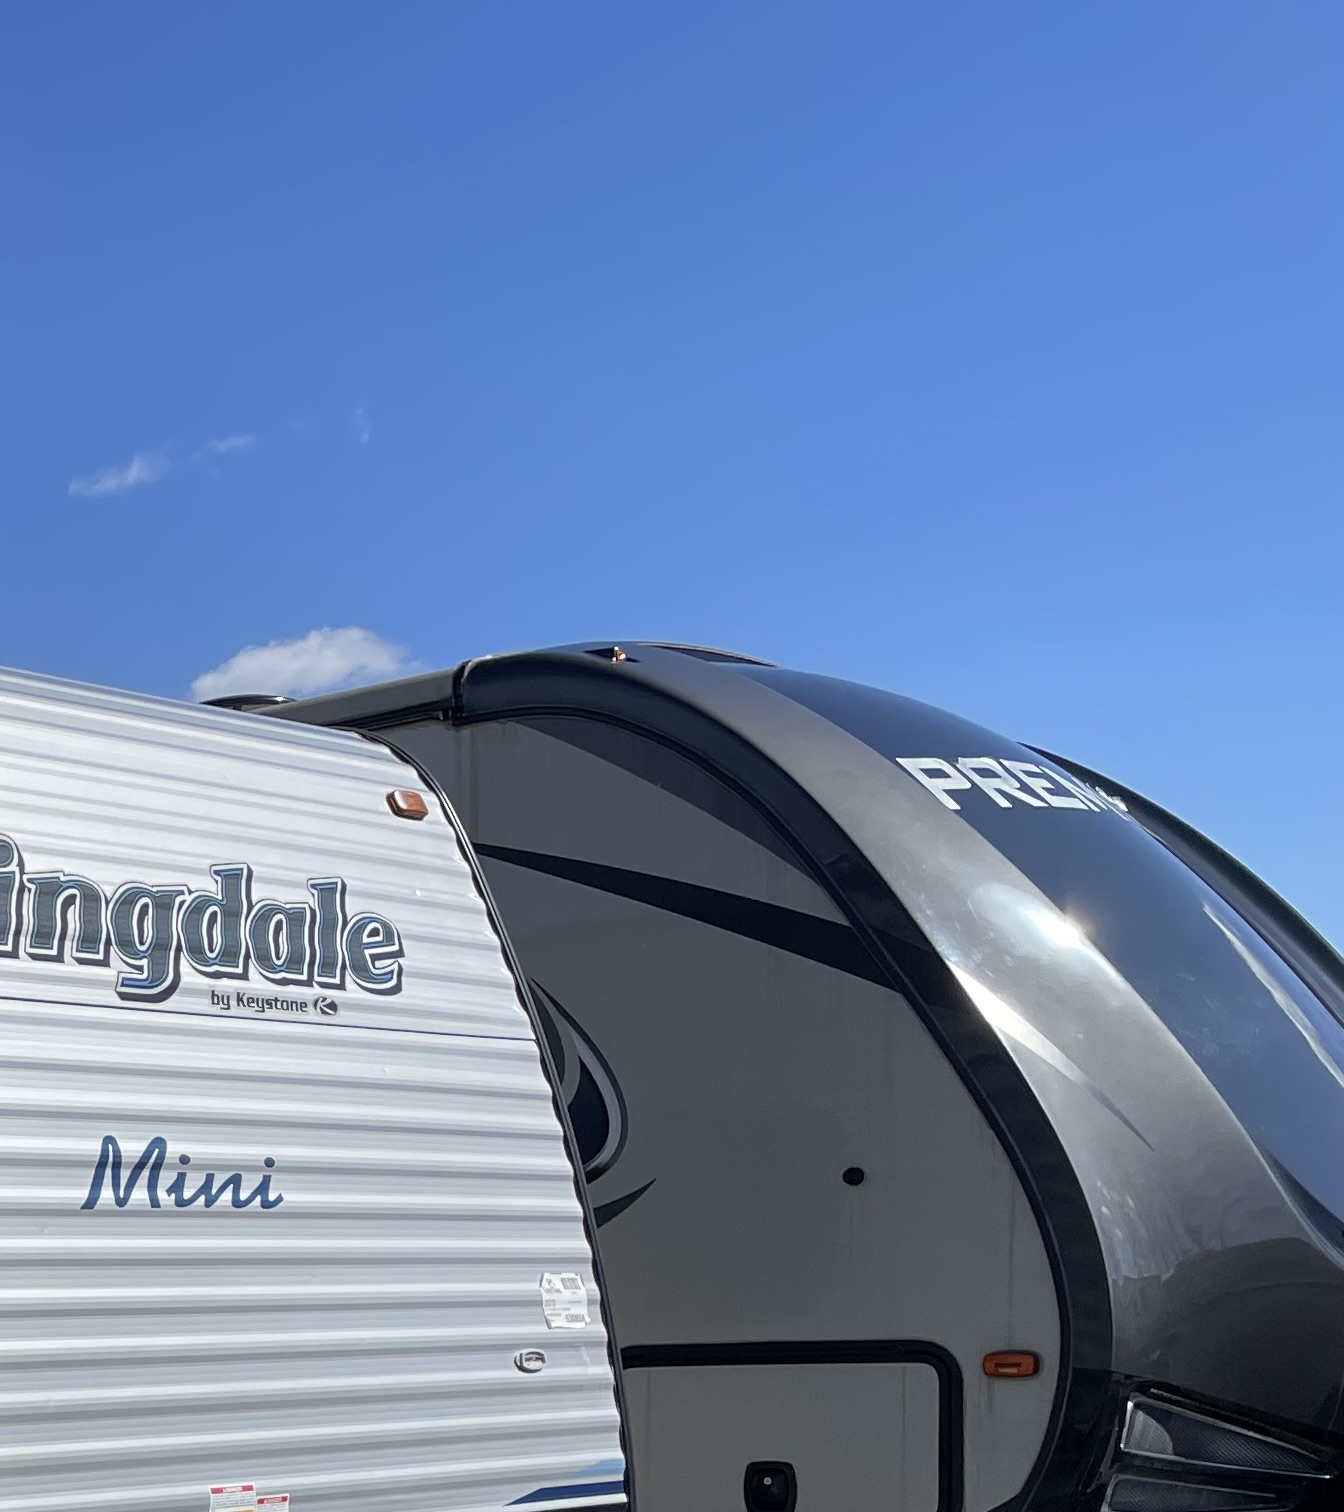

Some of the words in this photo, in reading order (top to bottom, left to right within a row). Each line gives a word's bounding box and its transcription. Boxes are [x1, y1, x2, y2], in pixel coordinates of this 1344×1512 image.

[896, 756, 1130, 821] PREM
[211, 989, 231, 1011] by
[236, 991, 309, 1013] Keystone
[80, 1135, 285, 1211] Mini
